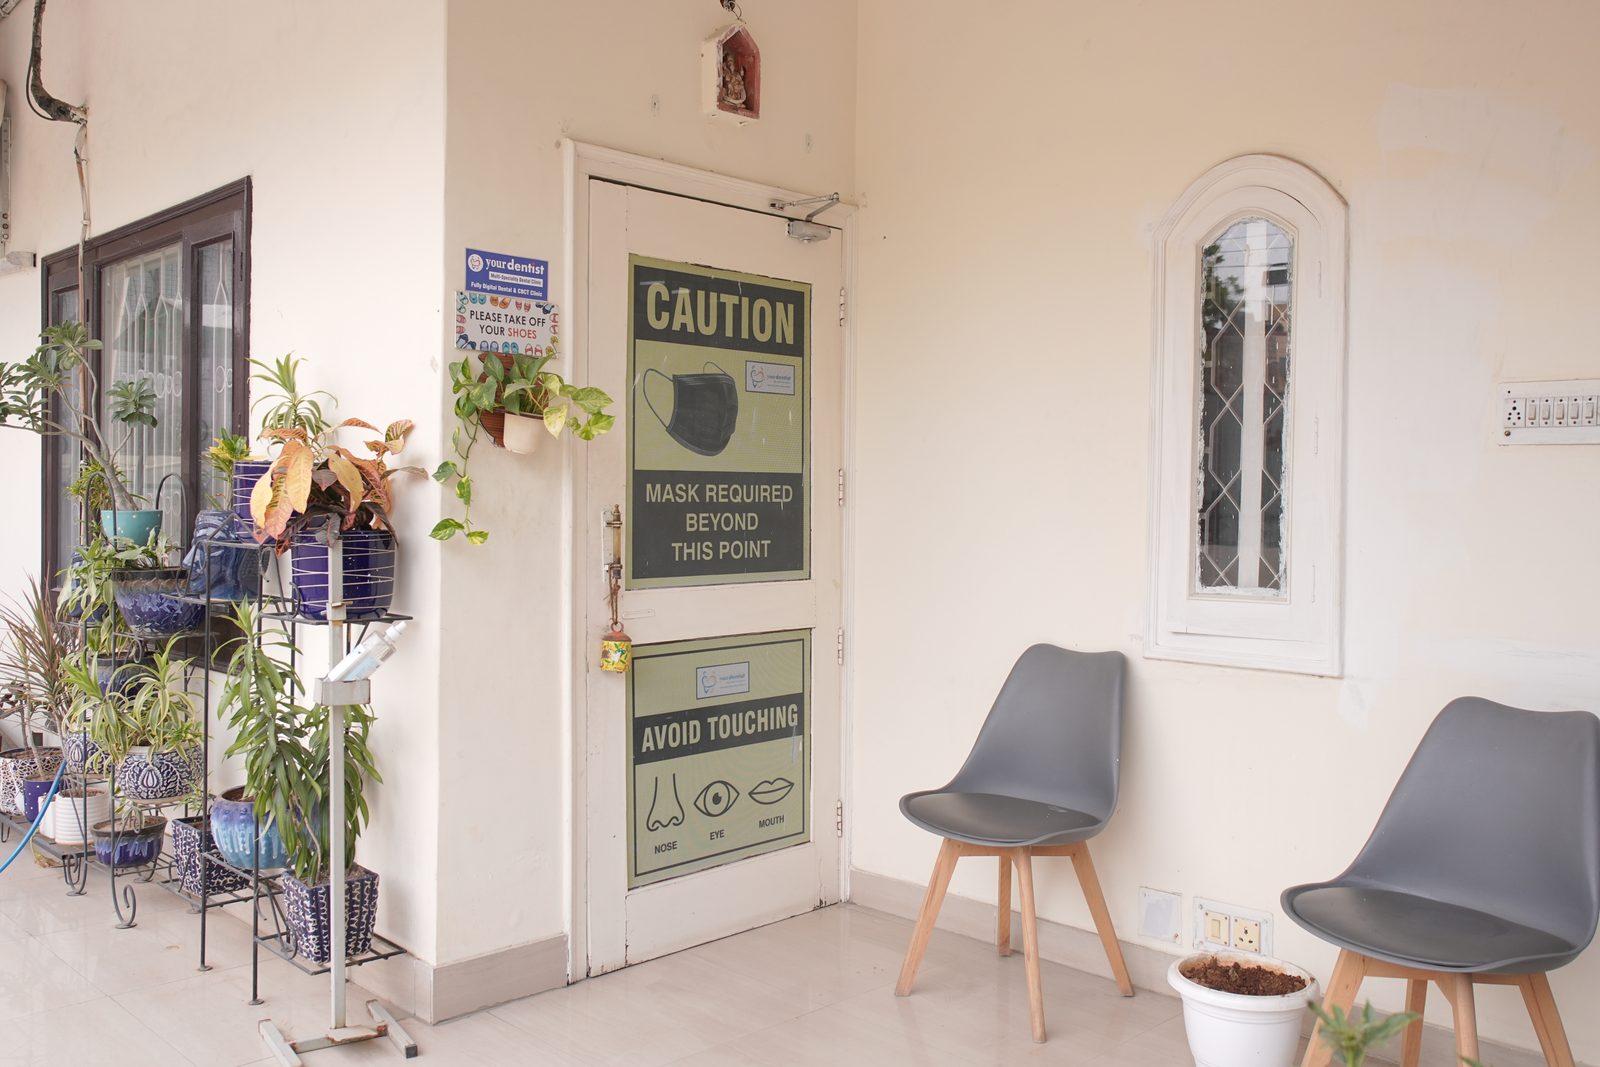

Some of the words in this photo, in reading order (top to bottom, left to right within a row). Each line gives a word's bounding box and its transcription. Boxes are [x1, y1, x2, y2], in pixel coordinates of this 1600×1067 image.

[471, 281, 482, 289] Fully
[470, 310, 502, 322] PLEASE
[504, 314, 526, 325] TAKE
[528, 317, 546, 327] OFF
[646, 282, 795, 345] CAUTION
[479, 324, 505, 336] YOUR
[508, 327, 537, 339] SHOES
[645, 483, 700, 503] MASK
[705, 484, 793, 503] REQUIRED
[686, 512, 759, 532] BEYOND
[671, 541, 713, 561] THIS
[719, 540, 771, 560] POINT
[641, 719, 701, 752] AVOID
[707, 703, 799, 741] TOUCHING
[758, 814, 785, 829] MOUTH
[709, 829, 725, 841] EYE
[654, 840, 678, 854] NOSE
